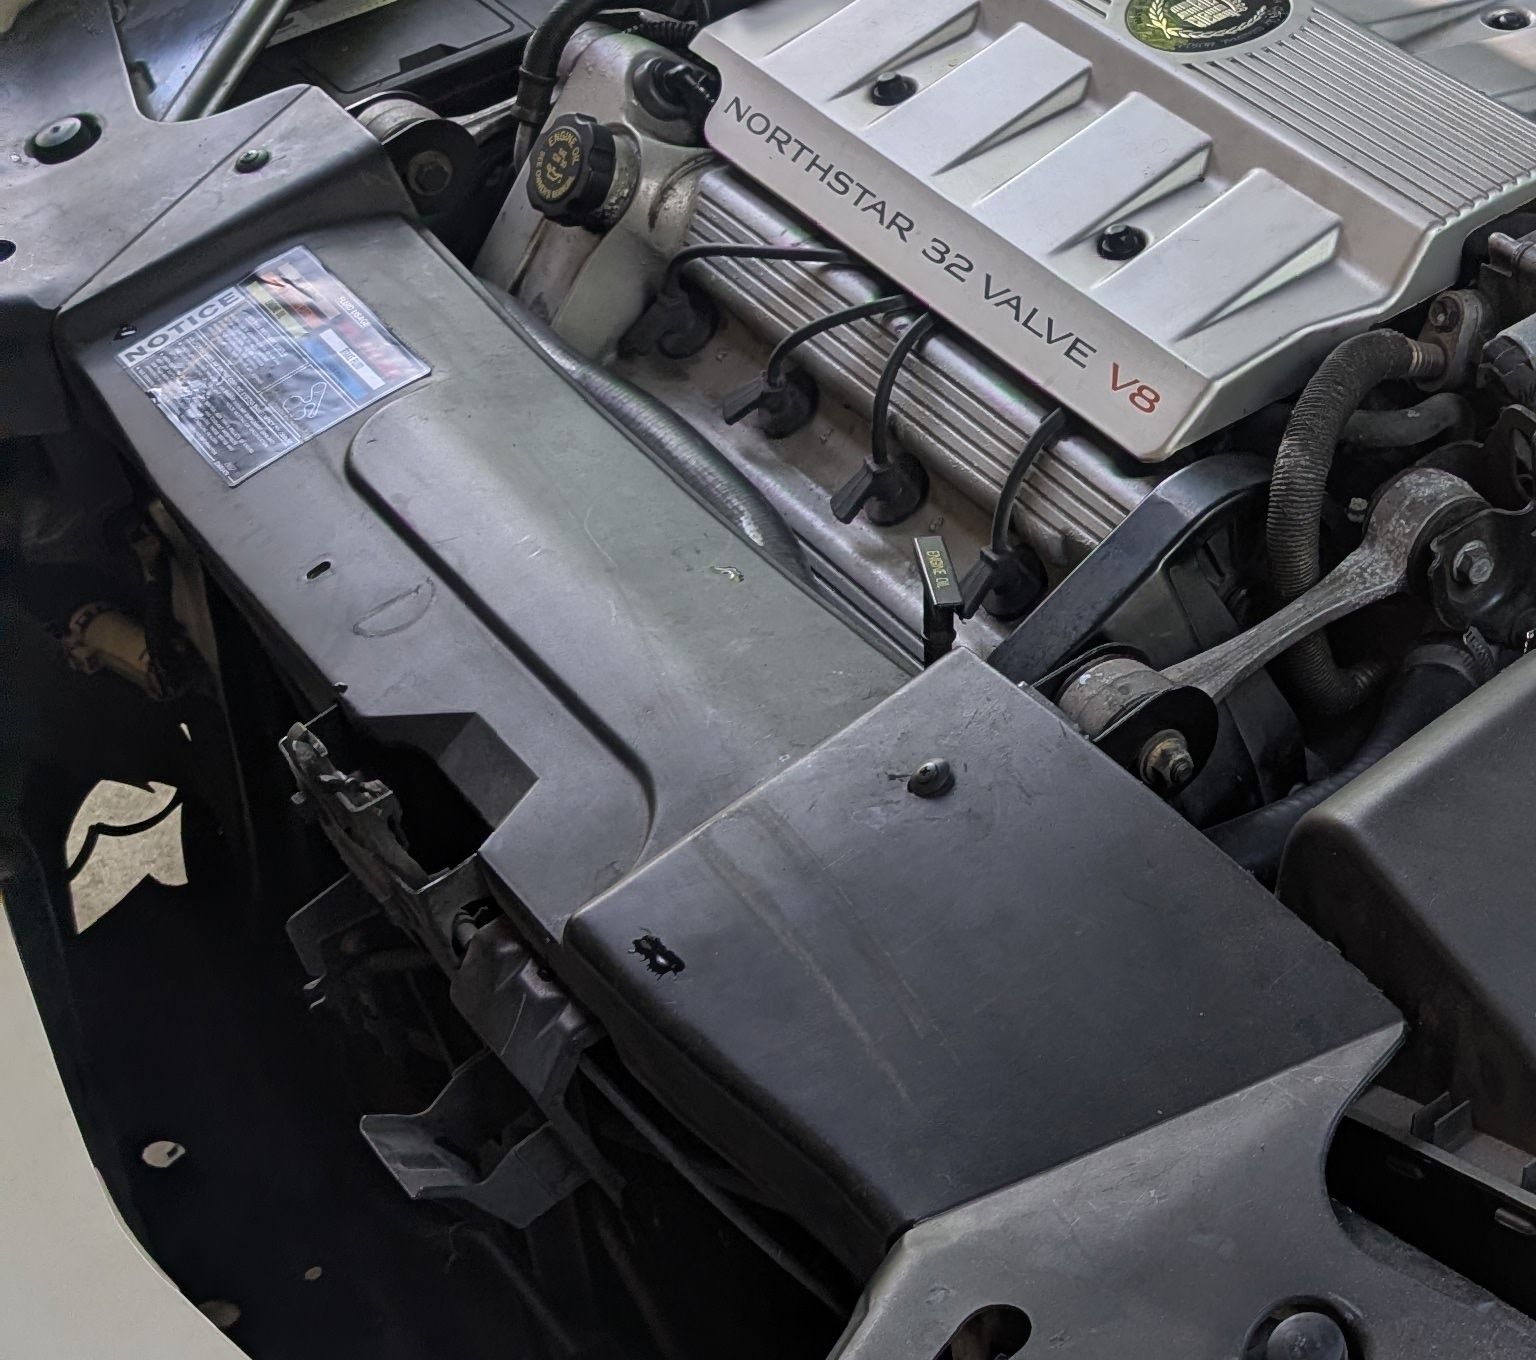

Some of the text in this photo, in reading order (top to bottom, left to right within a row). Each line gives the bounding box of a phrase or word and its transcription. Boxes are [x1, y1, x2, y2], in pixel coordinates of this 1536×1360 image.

[124, 291, 240, 363] NOTICE
[724, 96, 1161, 414] NORTHSTAR 32 VALVE V8
